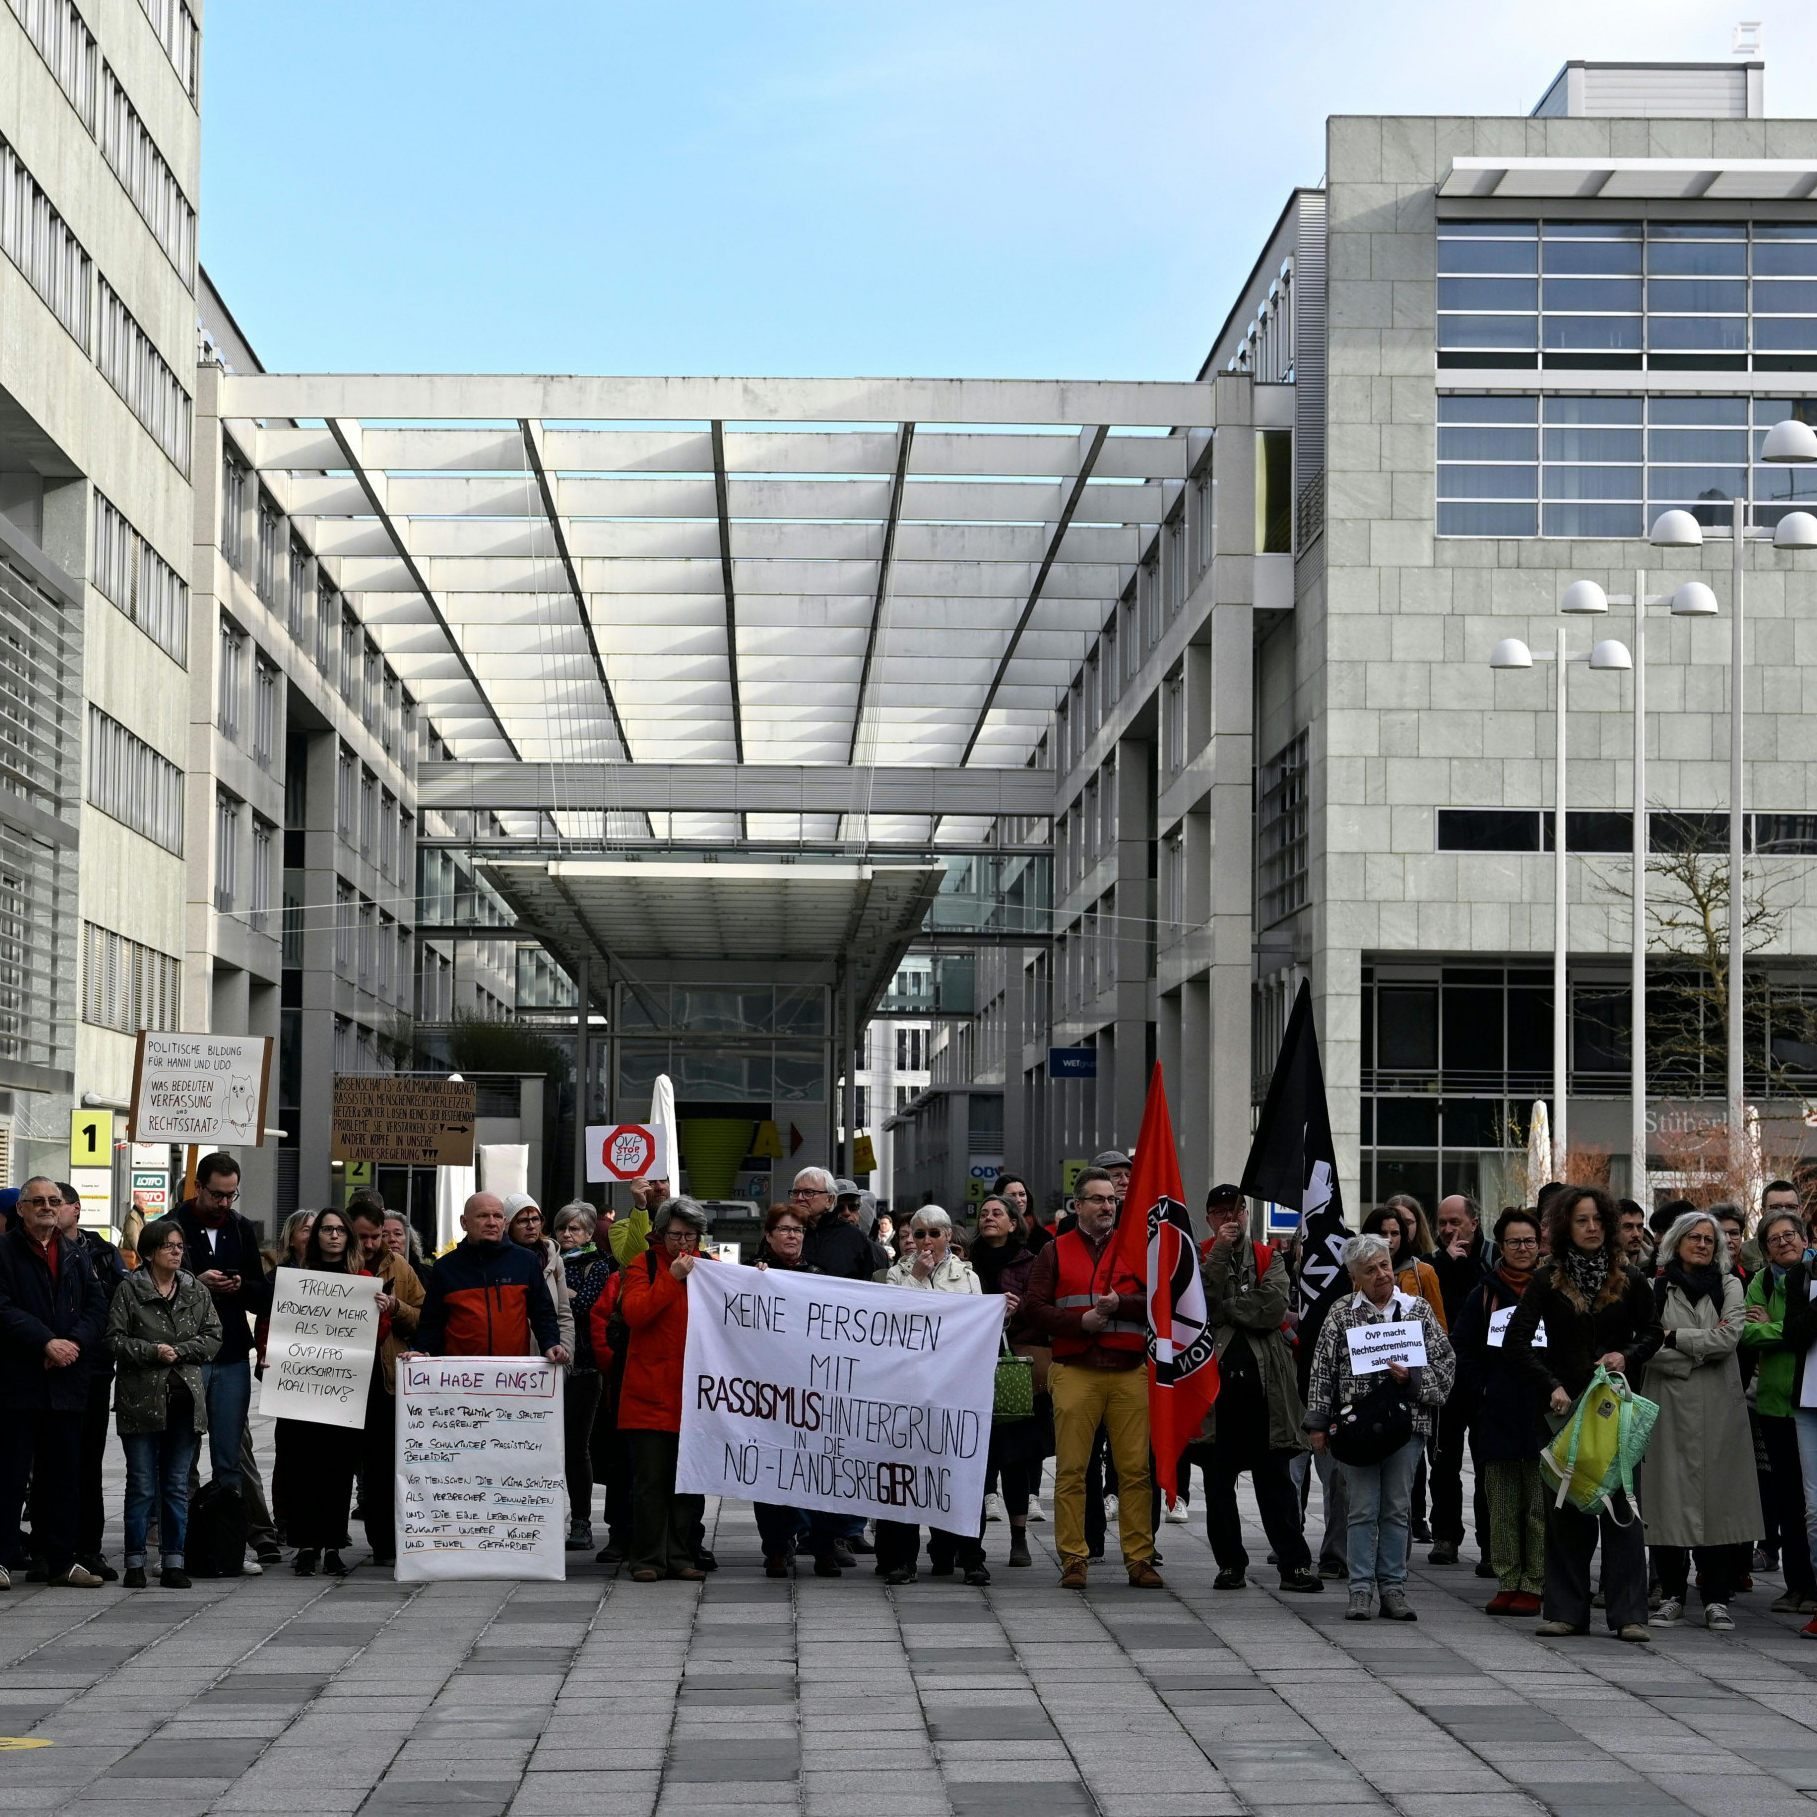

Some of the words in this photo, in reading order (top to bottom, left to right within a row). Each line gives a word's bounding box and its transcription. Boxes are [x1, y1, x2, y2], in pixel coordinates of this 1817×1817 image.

[148, 1041, 201, 1055] POLITISCHE
[207, 1045, 242, 1056] BILDUNG
[148, 1056, 163, 1068] FÜR
[167, 1058, 191, 1068] HANNI
[194, 1059, 210, 1070] UND
[213, 1060, 232, 1071] UDO
[151, 1080, 168, 1092] WAS
[171, 1080, 214, 1092] BEDEUTEN
[150, 1094, 212, 1109] VERFASSUNG
[148, 1116, 219, 1133] RECHTSSTAAT?
[373, 1120, 383, 1132] SIE
[82, 1124, 96, 1152] 1
[340, 1133, 367, 1146] ANDERE
[395, 1135, 404, 1147] IN
[406, 1136, 433, 1148] UNSERE
[349, 1146, 420, 1161] LANDESREGIERUNG
[136, 1177, 163, 1186] LOTTO
[299, 1279, 355, 1298] FRAUEN
[276, 1300, 332, 1318] VERDIENEN
[337, 1308, 368, 1322] MEHR
[723, 1292, 787, 1334] KEINE
[806, 1302, 942, 1351] PERSONEN
[295, 1321, 319, 1335] ALS
[325, 1324, 358, 1338] DIESE
[1365, 1331, 1380, 1340] ÖVP
[1382, 1328, 1406, 1338] macht
[1351, 1340, 1422, 1356] Rechtsextremismus
[280, 1360, 358, 1379] RÜCKSCHRITTS-
[810, 1353, 860, 1393] MIT
[408, 1368, 430, 1387] ICH
[440, 1371, 485, 1388] HABE
[495, 1371, 549, 1391] ANGST
[408, 1420, 425, 1429] UND
[432, 1420, 489, 1429] AUSGRENZT
[697, 1375, 980, 1459] RASSISMUSHINTERGRUND
[793, 1431, 807, 1450] IN
[823, 1436, 846, 1457] DIE
[425, 1474, 472, 1485] MENSCHEN
[405, 1491, 424, 1502] ALS
[432, 1491, 487, 1502] VERBRECHER
[406, 1511, 425, 1519] UND
[486, 1511, 546, 1523] LEBENSWERTE
[404, 1523, 452, 1534] ZUKUNFT
[458, 1525, 496, 1535] UNSERER
[405, 1540, 425, 1549] UND
[433, 1540, 465, 1548] ENKEL
